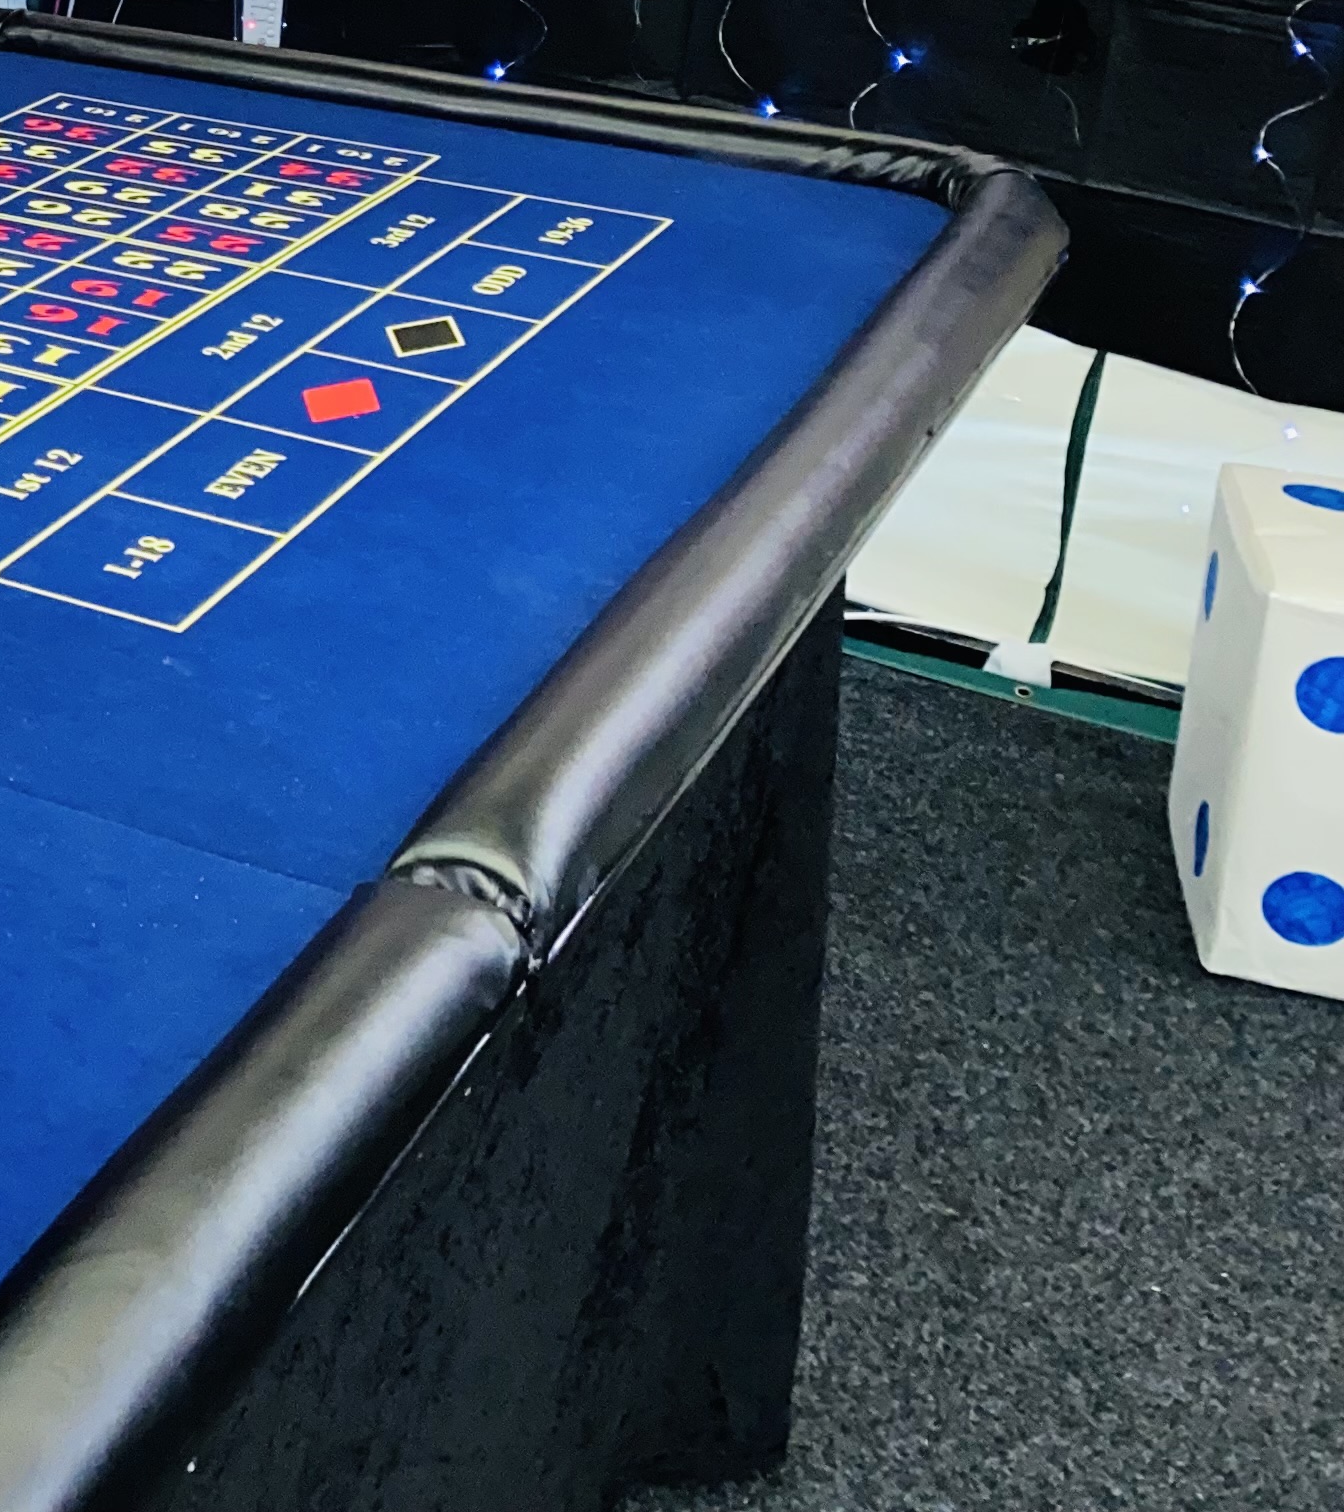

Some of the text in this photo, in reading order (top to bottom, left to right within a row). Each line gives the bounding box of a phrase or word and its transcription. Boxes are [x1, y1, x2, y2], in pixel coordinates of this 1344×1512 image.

[63, 180, 167, 205] 29
[243, 181, 349, 208] 31
[23, 199, 128, 227] 26
[198, 203, 306, 230] 28
[157, 225, 266, 254] 25
[370, 213, 436, 248] 3rd 12
[113, 250, 223, 280] 22
[471, 264, 527, 295] ODD
[70, 279, 174, 308] 19
[23, 303, 130, 336] 16
[200, 313, 284, 361] 2nd 12
[34, 448, 83, 473] 12
[203, 448, 288, 500] EVEN
[102, 535, 176, 580] 1-18
